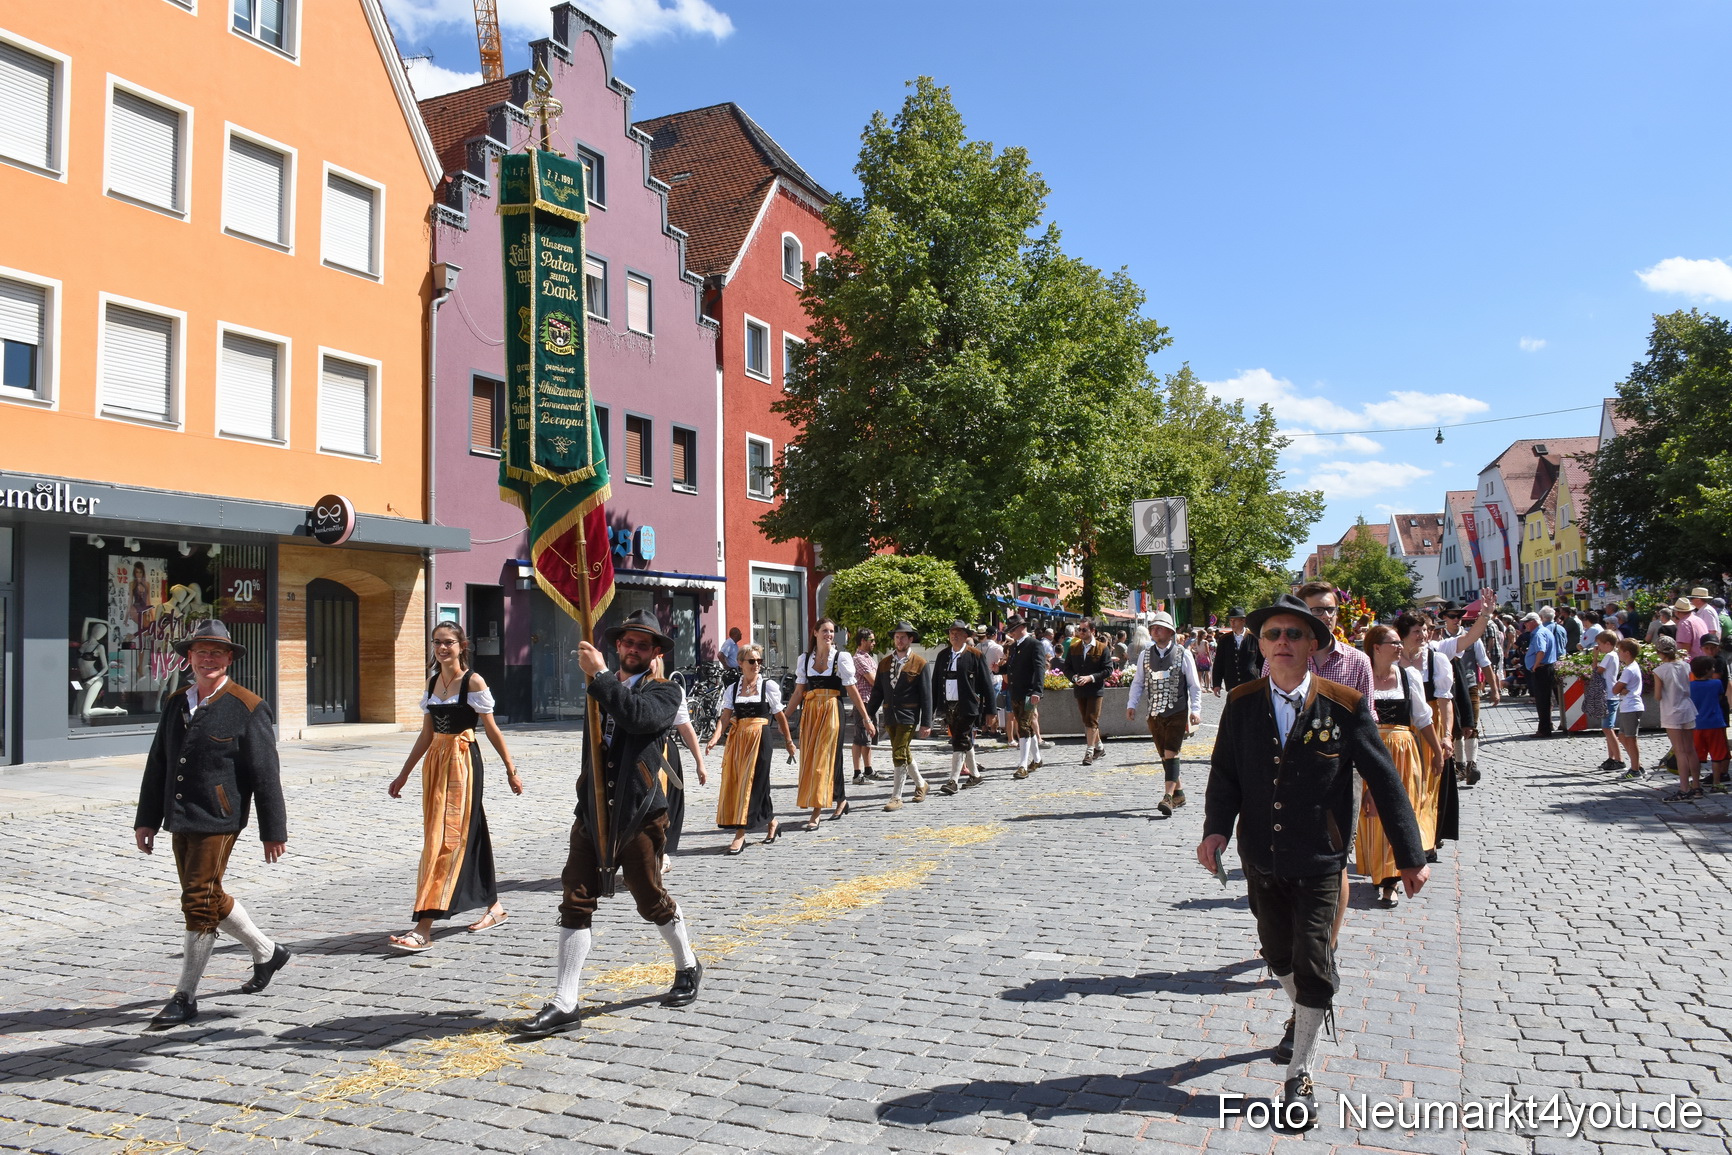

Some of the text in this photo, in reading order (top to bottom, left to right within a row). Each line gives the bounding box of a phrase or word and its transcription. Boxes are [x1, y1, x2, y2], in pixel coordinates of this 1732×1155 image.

[541, 237, 573, 254] Unserem
[541, 251, 577, 274] Paten
[550, 272, 569, 284] zum
[542, 280, 578, 302] Dank
[541, 412, 584, 429] Berngau
